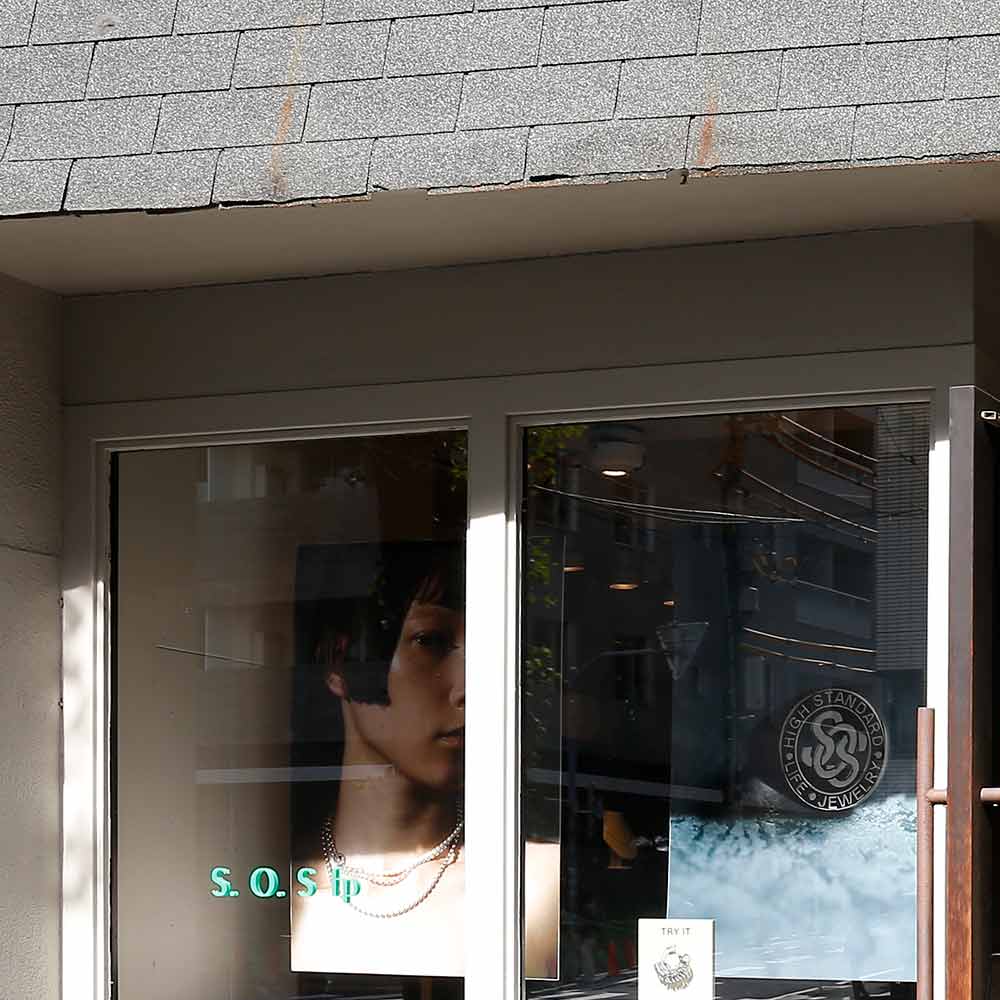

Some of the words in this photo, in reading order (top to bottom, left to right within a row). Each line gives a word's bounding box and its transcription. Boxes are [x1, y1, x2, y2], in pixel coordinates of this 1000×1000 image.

[784, 704, 811, 748] HIGH
[813, 691, 884, 746] STANDARD
[784, 760, 809, 796] LIFE
[817, 760, 881, 809] JEWELRY
[661, 927, 680, 936] TRY
[682, 927, 691, 936] IT
